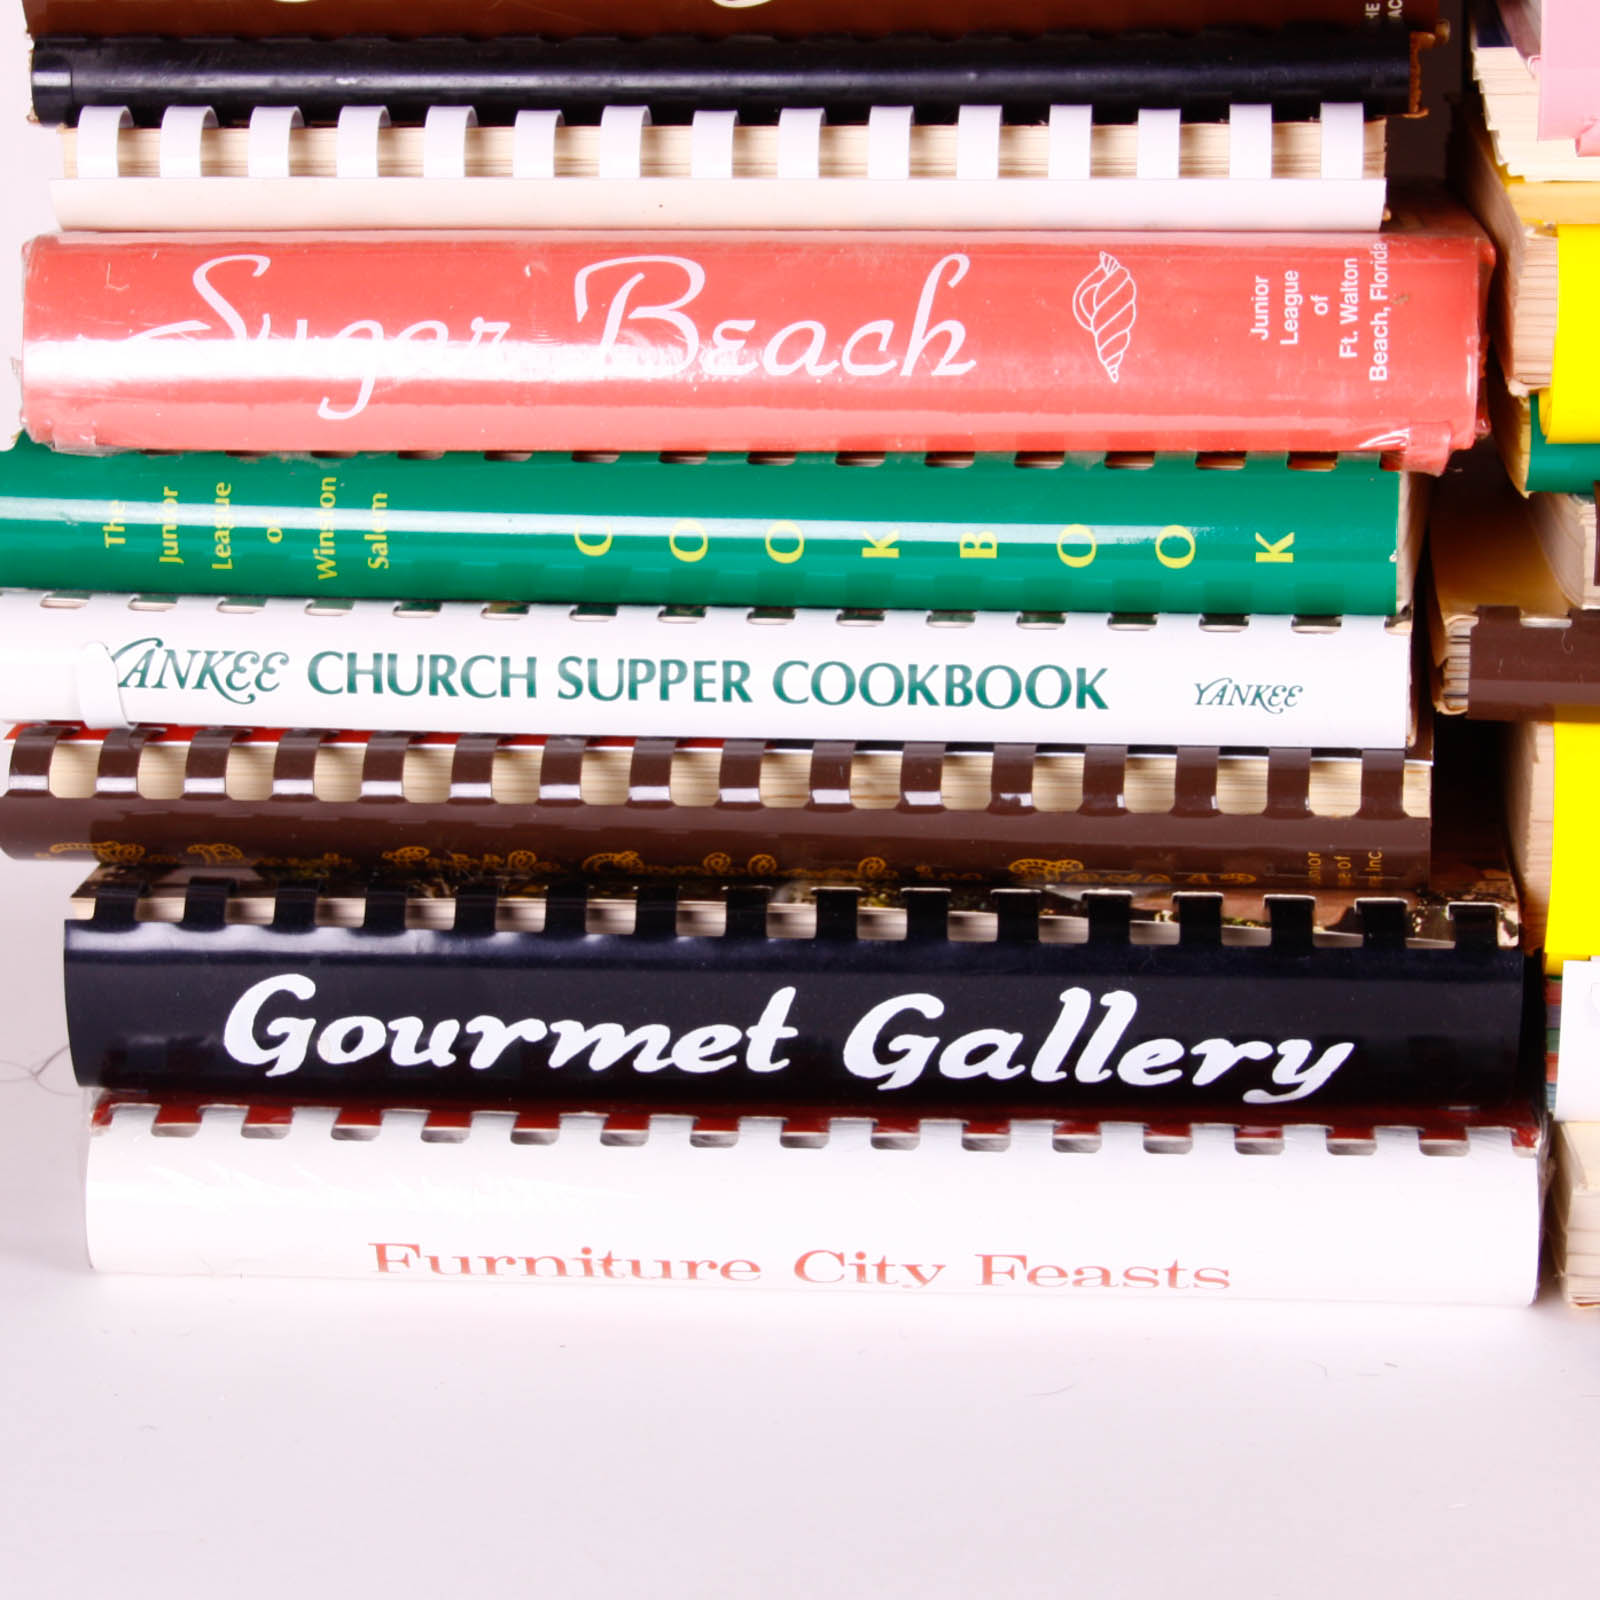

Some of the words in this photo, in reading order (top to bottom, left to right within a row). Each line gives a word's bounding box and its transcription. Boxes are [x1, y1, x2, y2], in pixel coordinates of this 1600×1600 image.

[1339, 258, 1359, 325] Walton
[1369, 242, 1388, 300] Florida
[574, 253, 976, 377] Beach
[1250, 275, 1269, 341] Junior
[1280, 270, 1303, 344] League
[1310, 295, 1329, 316] of
[1339, 330, 1359, 358] Ft.
[1369, 307, 1391, 381] Beach,
[103, 500, 126, 548] The
[157, 486, 184, 564] Junior
[212, 482, 234, 569] League
[259, 514, 283, 543] of
[313, 477, 338, 580] Winston
[364, 492, 389, 569] Salem
[308, 651, 537, 699] CHURCH
[558, 656, 753, 703] SUPPER
[773, 660, 1109, 710] COOKBOOK
[1193, 677, 1304, 714] YANKEE
[223, 973, 798, 1077] Gourmet
[843, 986, 1355, 1103] Gallery
[367, 1242, 762, 1281] Furniture
[793, 1249, 947, 1288] City
[973, 1253, 1231, 1289] Feasts
